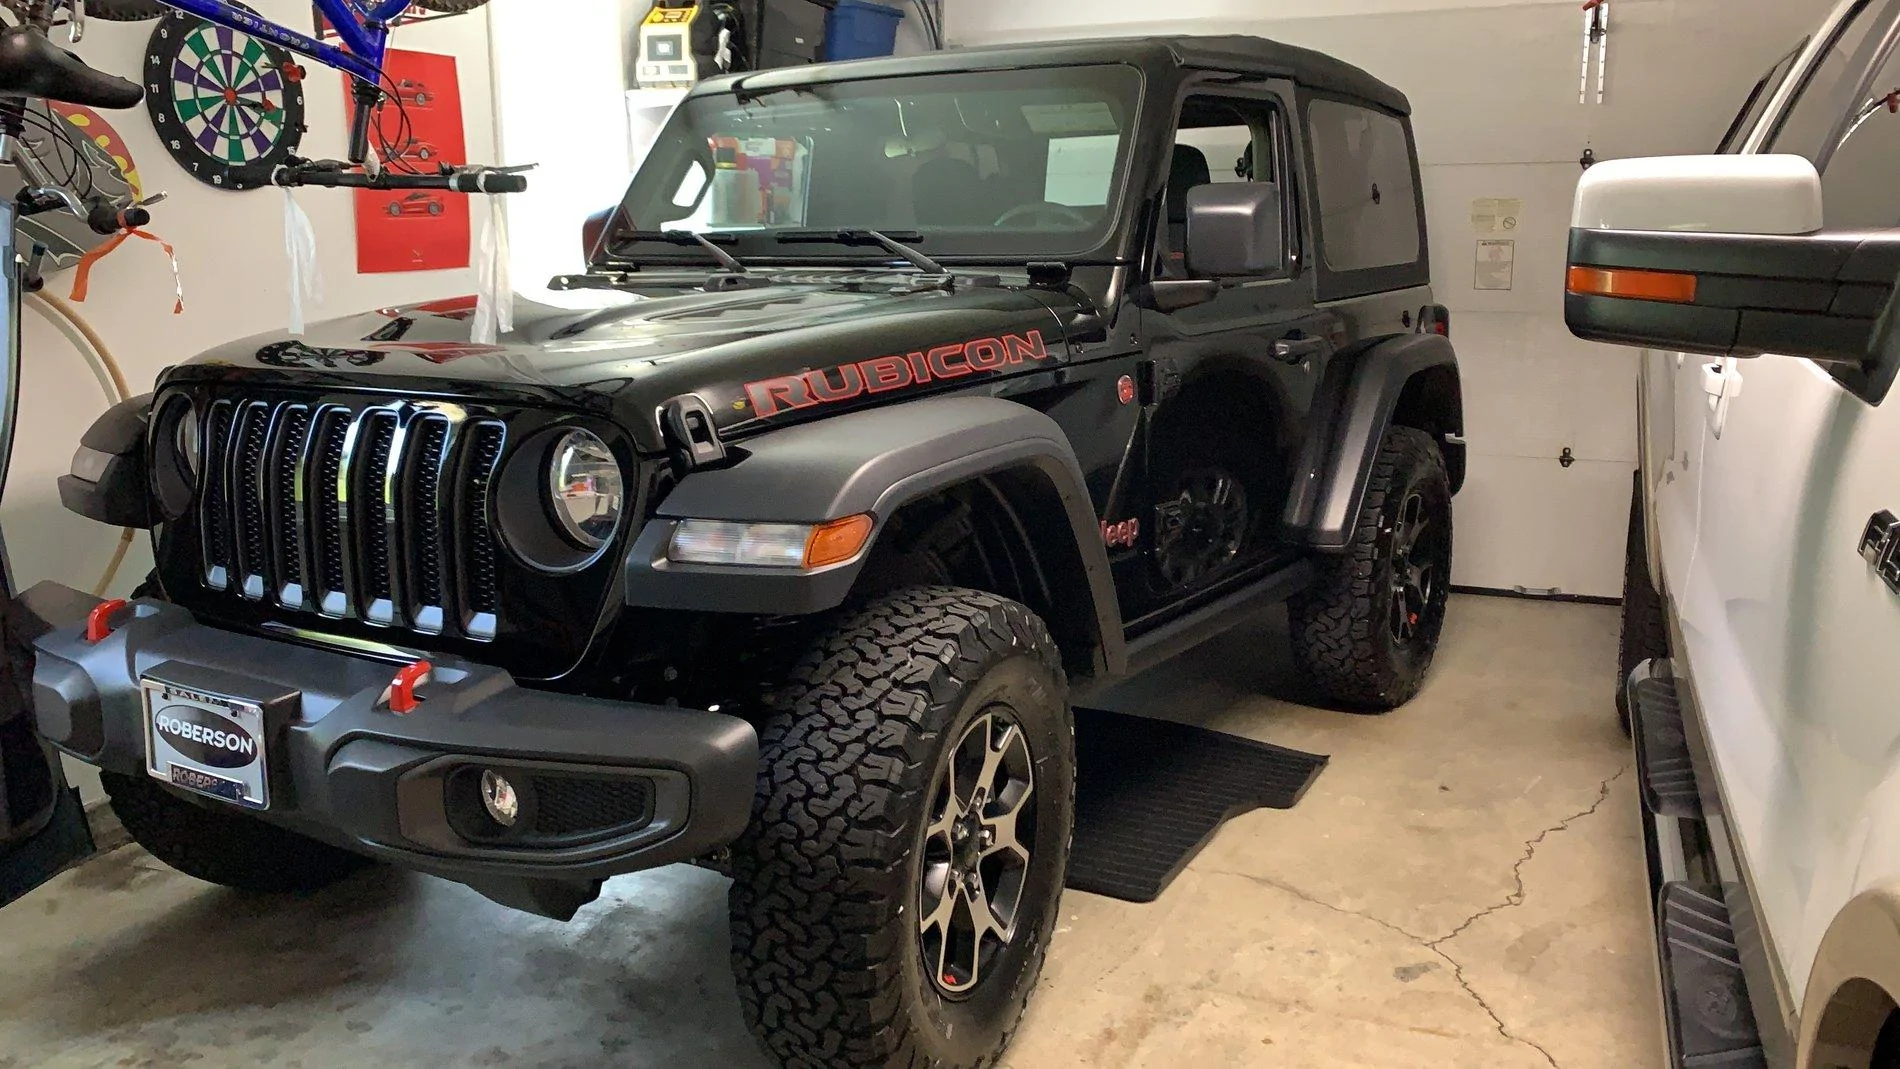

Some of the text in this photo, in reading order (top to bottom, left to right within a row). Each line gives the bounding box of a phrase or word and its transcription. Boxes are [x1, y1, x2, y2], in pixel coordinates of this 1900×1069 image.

[174, 10, 184, 19] 12
[160, 28, 168, 39] 9
[231, 11, 310, 49] FRONTIER
[150, 54, 160, 65] 14
[151, 84, 159, 93] 11
[296, 95, 303, 106] 6
[158, 113, 166, 123] 8
[170, 140, 181, 150] 16
[192, 162, 199, 172] 7
[212, 174, 222, 184] 19
[743, 329, 1048, 418] RUBICON
[158, 715, 253, 756] ROBERSON
